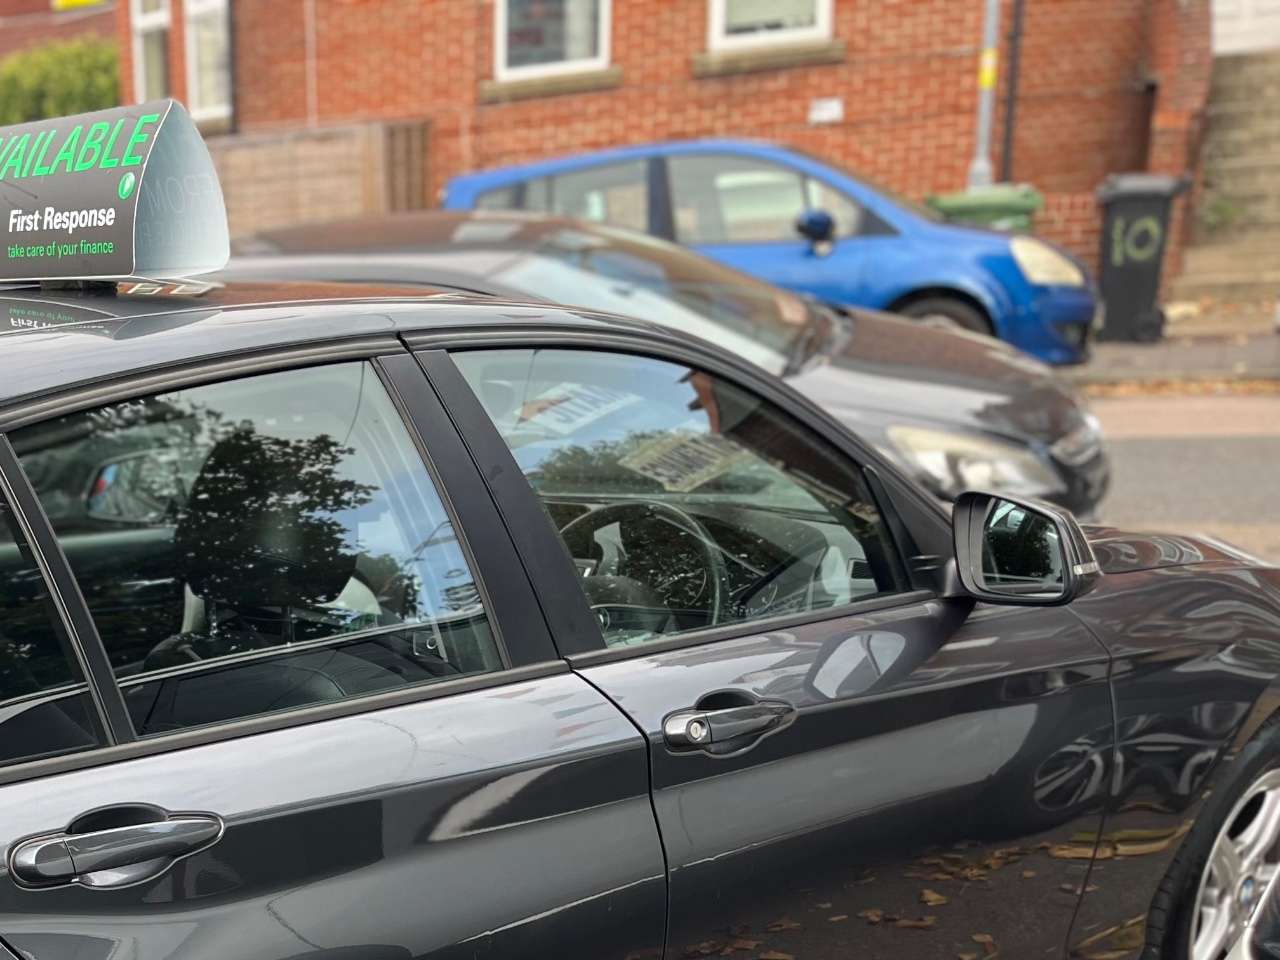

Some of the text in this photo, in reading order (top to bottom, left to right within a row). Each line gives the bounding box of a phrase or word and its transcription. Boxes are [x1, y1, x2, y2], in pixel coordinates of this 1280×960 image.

[9, 205, 116, 234] First Response
[8, 239, 114, 259] take care of your finance
[1111, 216, 1162, 267] 10
